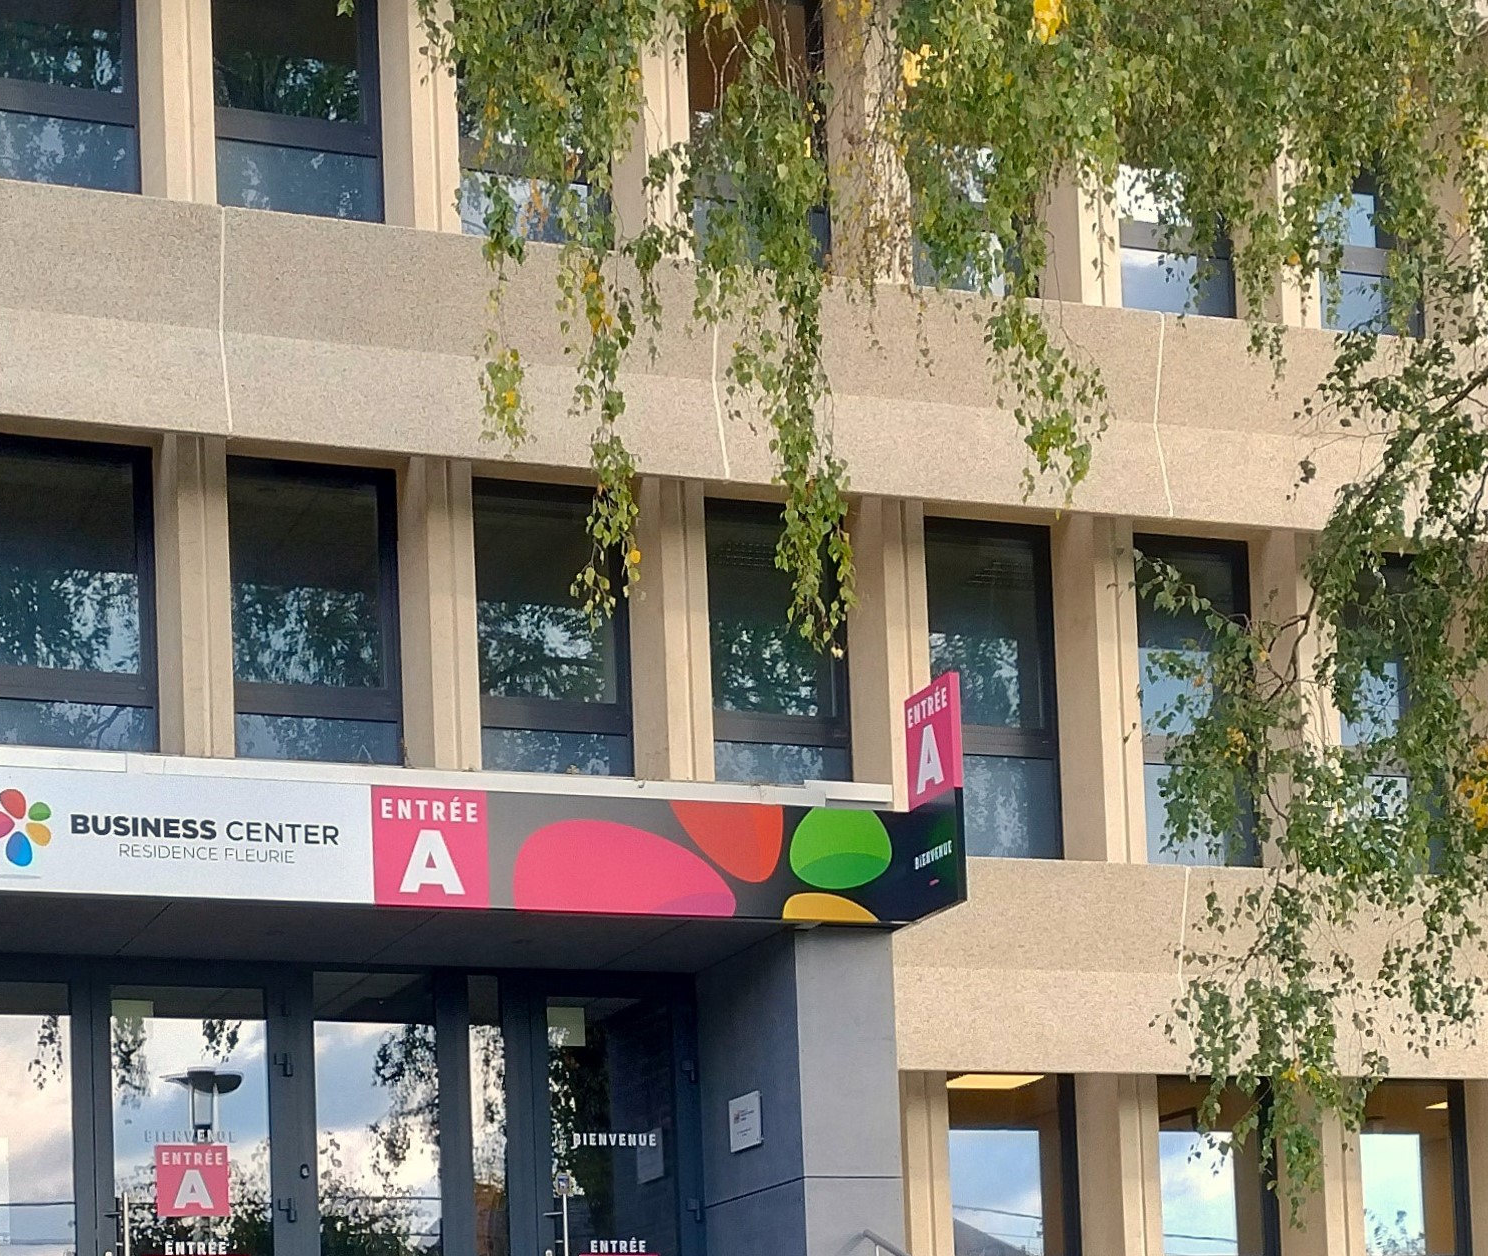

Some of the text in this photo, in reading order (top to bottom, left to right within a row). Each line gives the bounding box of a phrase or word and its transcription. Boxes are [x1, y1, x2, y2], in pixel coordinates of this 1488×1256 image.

[907, 684, 948, 728] ENTRÉE
[916, 724, 945, 795] A
[381, 796, 478, 823] ENTRÉE
[70, 813, 340, 846] BUSINESS CENTER
[118, 842, 295, 864] RESIDENCE FLEURIE
[399, 829, 465, 895] A
[915, 840, 953, 870] BIENVENUE
[144, 1129, 237, 1144] BIENVENUE
[572, 1133, 657, 1147] BIENVENUE
[162, 1150, 223, 1166] ENTRÉE
[173, 1169, 214, 1209] A
[164, 1238, 227, 1255] ENTRÉE
[590, 1237, 647, 1253] ENTRÉE
